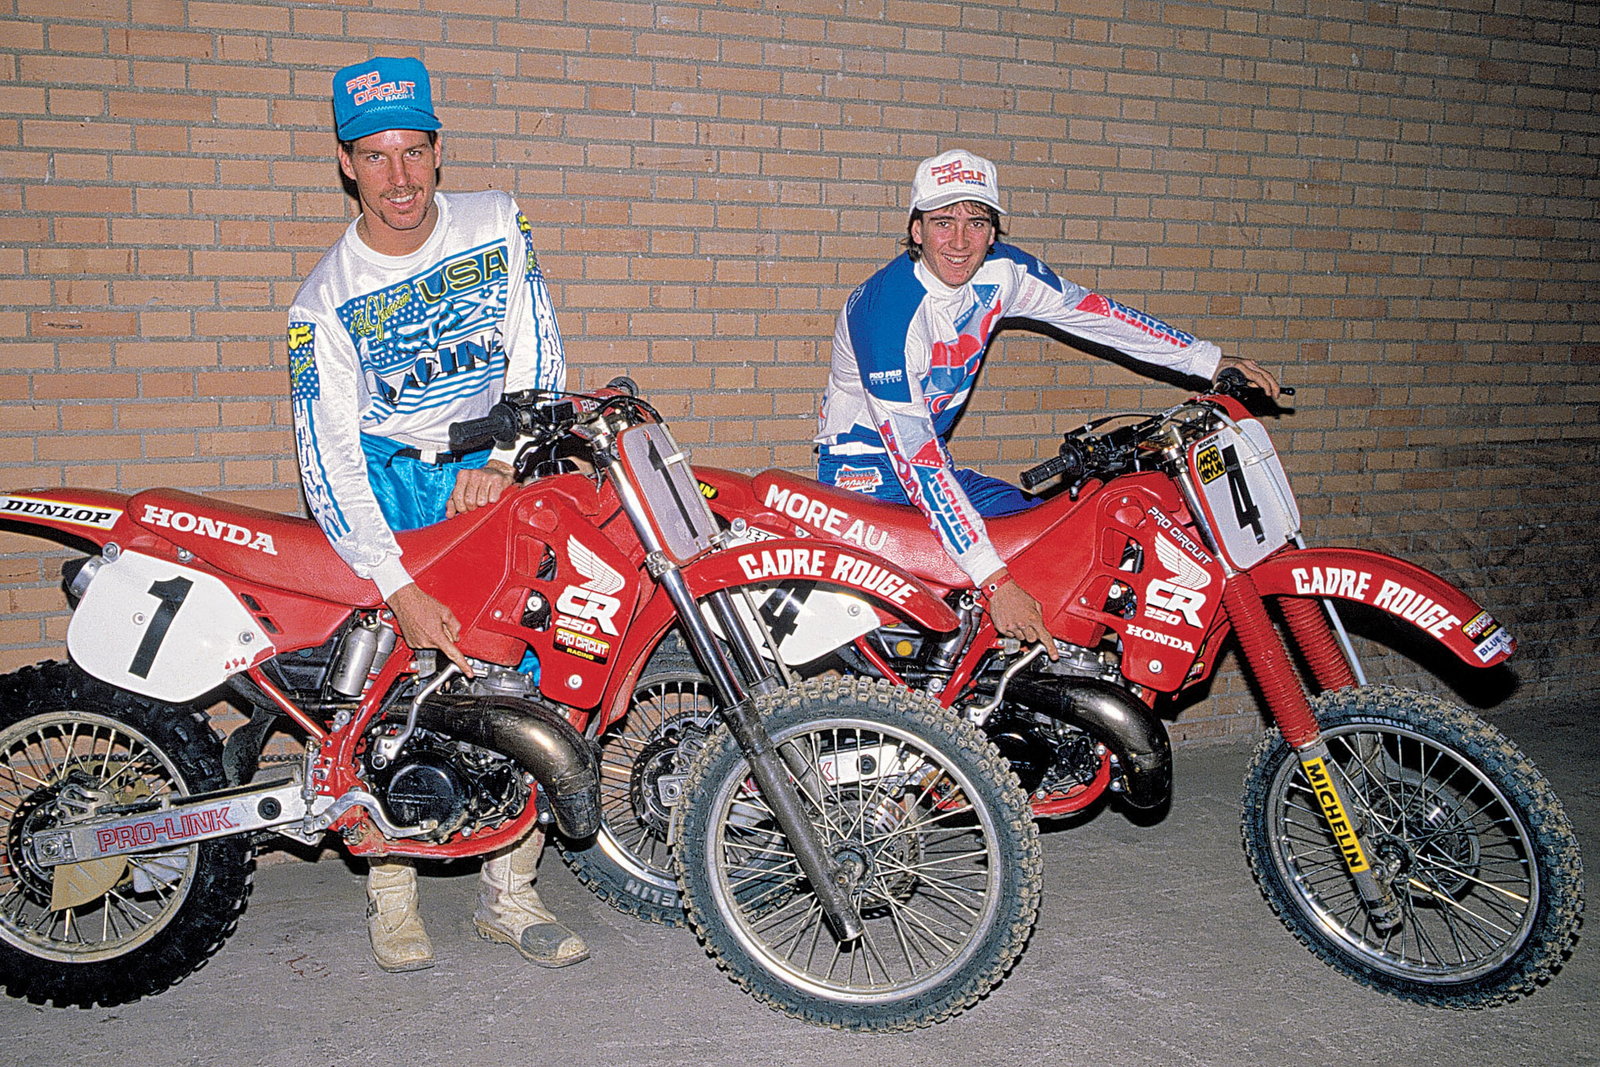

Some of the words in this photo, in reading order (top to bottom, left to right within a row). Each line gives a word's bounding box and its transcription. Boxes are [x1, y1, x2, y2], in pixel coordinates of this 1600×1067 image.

[346, 71, 381, 94] PRO
[354, 81, 416, 106] CIRCUIT
[931, 160, 962, 176] PRO
[937, 170, 986, 186] CIRCUIT
[416, 247, 508, 303] USA
[869, 371, 885, 380] PRO
[885, 369, 902, 378] PAD
[1, 499, 112, 524] DUNLOP
[648, 440, 699, 539] 1
[1222, 443, 1266, 544] 4
[140, 504, 279, 556] HONDA
[763, 484, 890, 551] MOREAU
[1148, 506, 1173, 530] PRO
[1169, 526, 1214, 565] CIRCUIT
[738, 549, 826, 580] CADRE
[830, 555, 919, 606] ROUGE
[555, 584, 621, 636] CR
[555, 615, 597, 635] 250
[1144, 606, 1182, 626] 250
[1145, 578, 1206, 628] CR
[1291, 566, 1372, 601] CADRE
[1373, 578, 1462, 639] ROUGE
[128, 575, 194, 680] 1
[556, 630, 576, 648] PRO
[575, 635, 609, 655] CIRCUIT
[1125, 624, 1196, 654] HONDA
[1479, 635, 1502, 656] BLUE
[566, 646, 595, 660] RACING
[96, 806, 233, 852] PRO-LINK
[1304, 762, 1364, 868] MICHELIN
